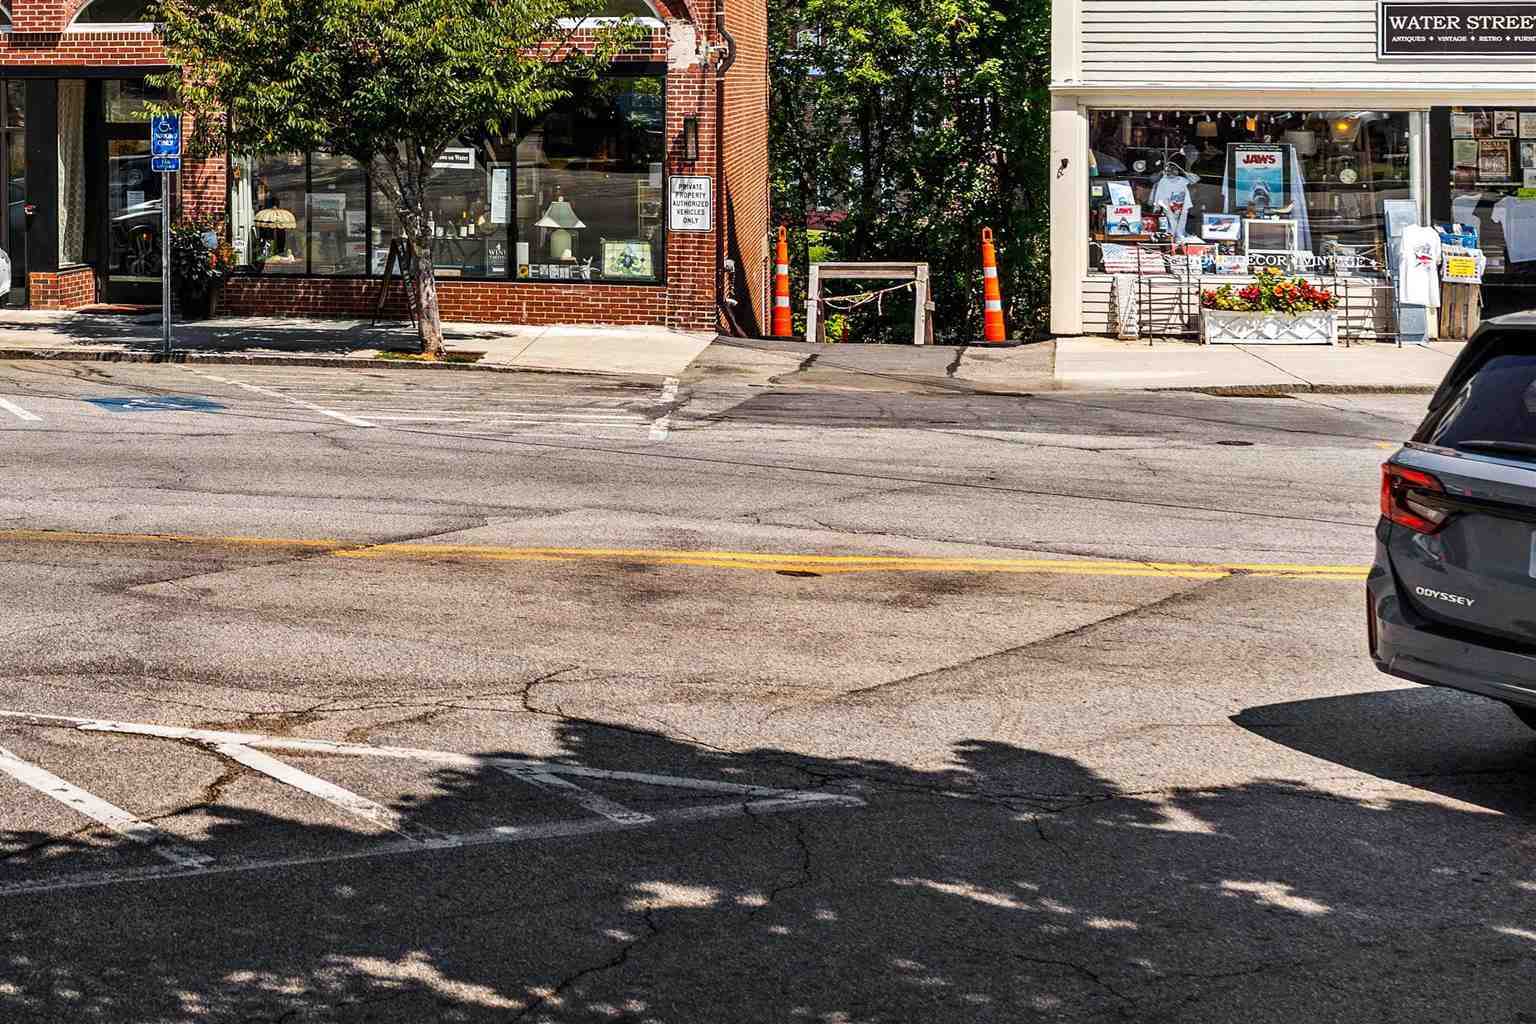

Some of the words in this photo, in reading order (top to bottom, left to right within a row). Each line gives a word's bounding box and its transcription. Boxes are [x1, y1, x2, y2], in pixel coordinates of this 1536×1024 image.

[1389, 15, 1462, 30] WATER
[1391, 35, 1426, 43] ANTIQUES
[1438, 35, 1467, 43] VINTAGE
[1479, 35, 1503, 43] RETRO
[1243, 154, 1276, 164] JAWS
[675, 191, 706, 199] PROPERTY
[672, 200, 710, 208] AUTHORIZED
[676, 208, 705, 216] VEHICLES
[682, 217, 699, 225] ONLY
[1415, 586, 1476, 608] ODYSSEY
